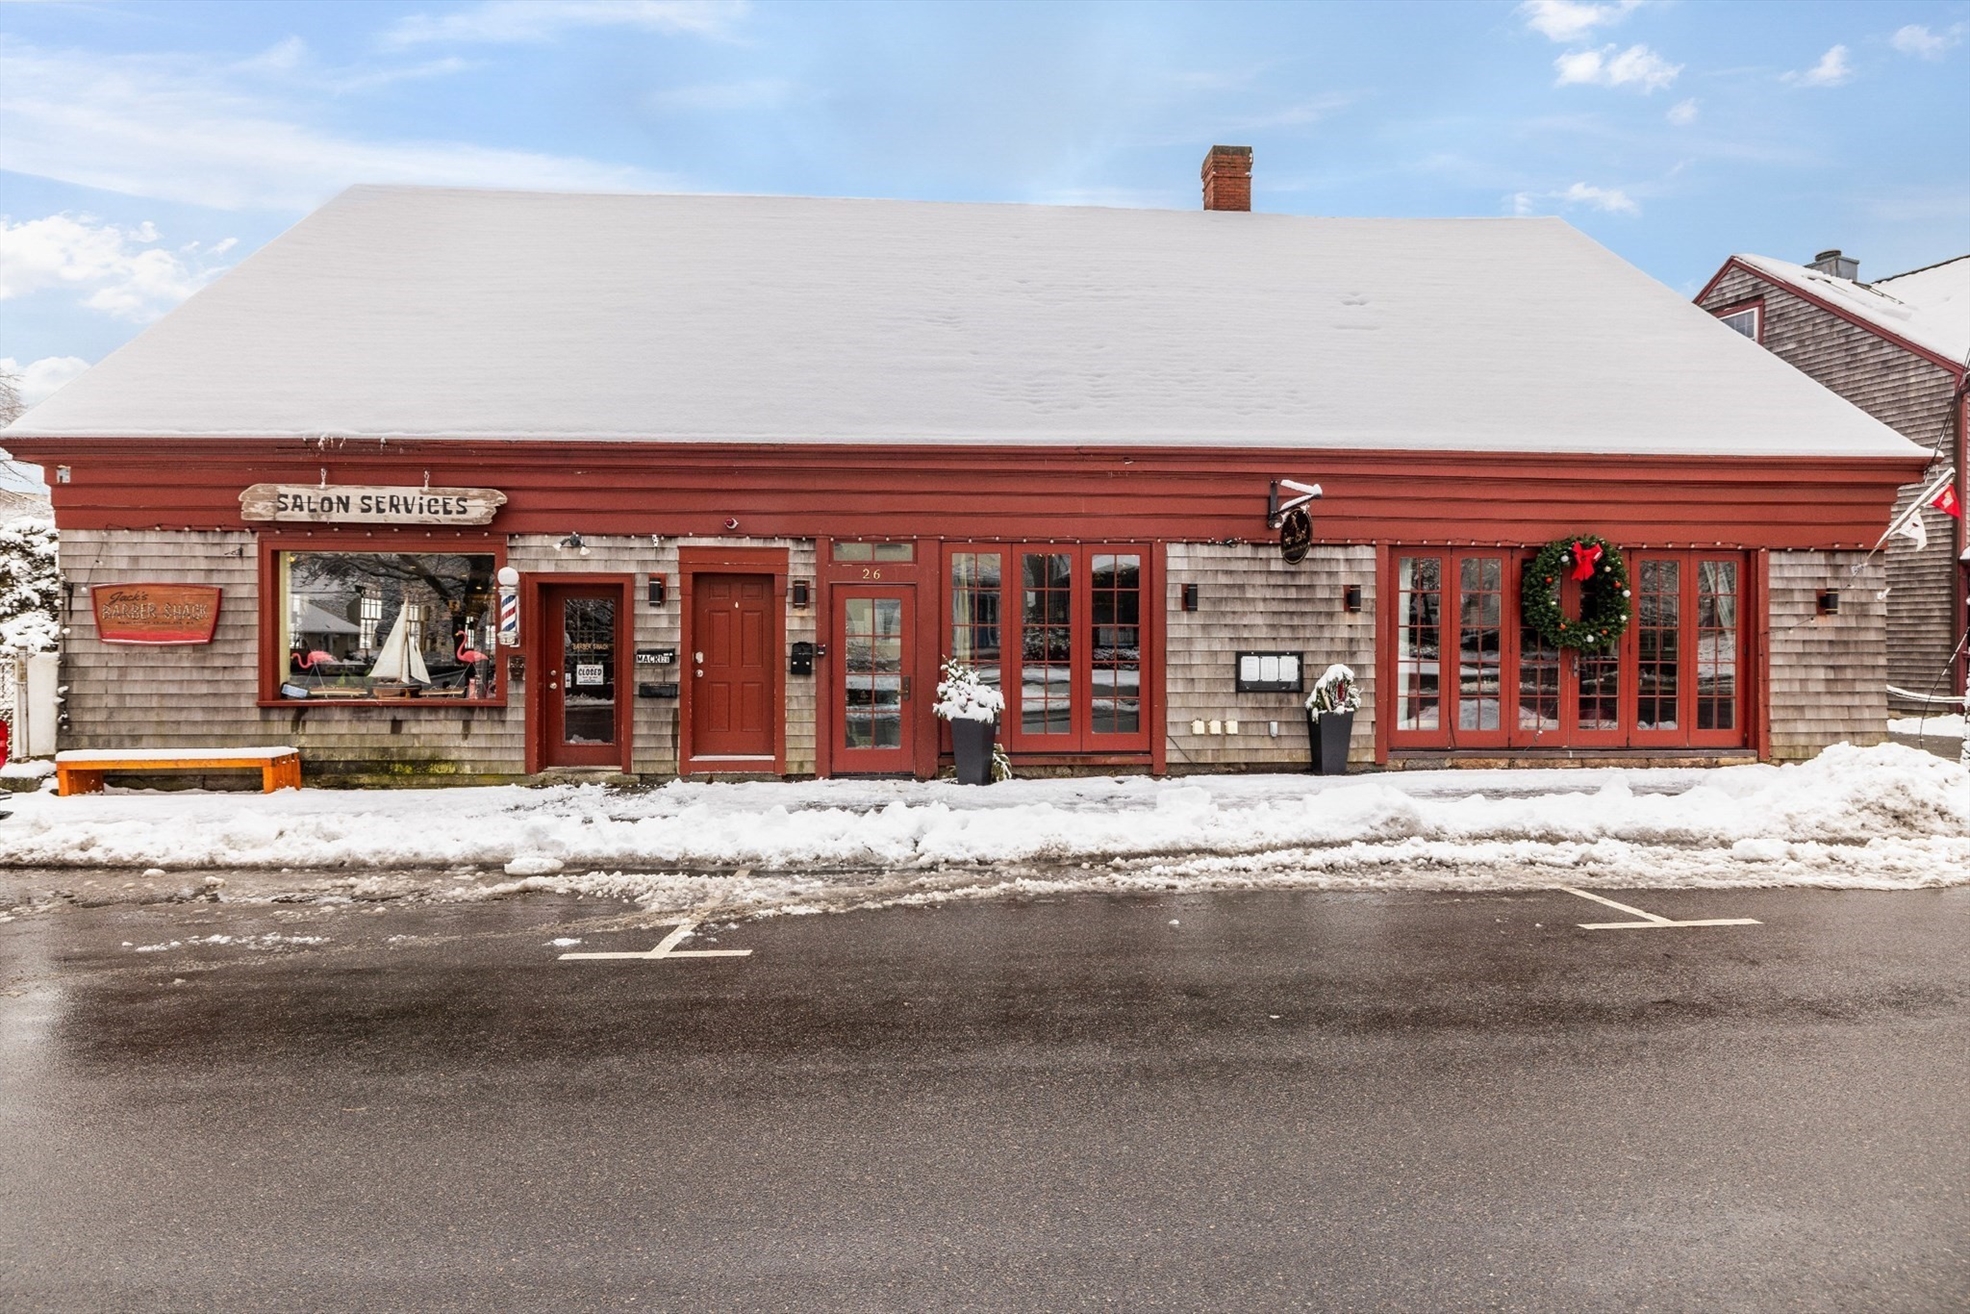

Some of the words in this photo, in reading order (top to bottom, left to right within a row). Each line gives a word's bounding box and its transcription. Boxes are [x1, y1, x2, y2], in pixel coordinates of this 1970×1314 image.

[277, 494, 350, 514] SALON
[862, 568, 880, 580] 26
[109, 591, 149, 605] Jack's
[102, 602, 156, 620] BARBER
[163, 603, 208, 621] SHACK
[578, 668, 602, 676] CLOSED
